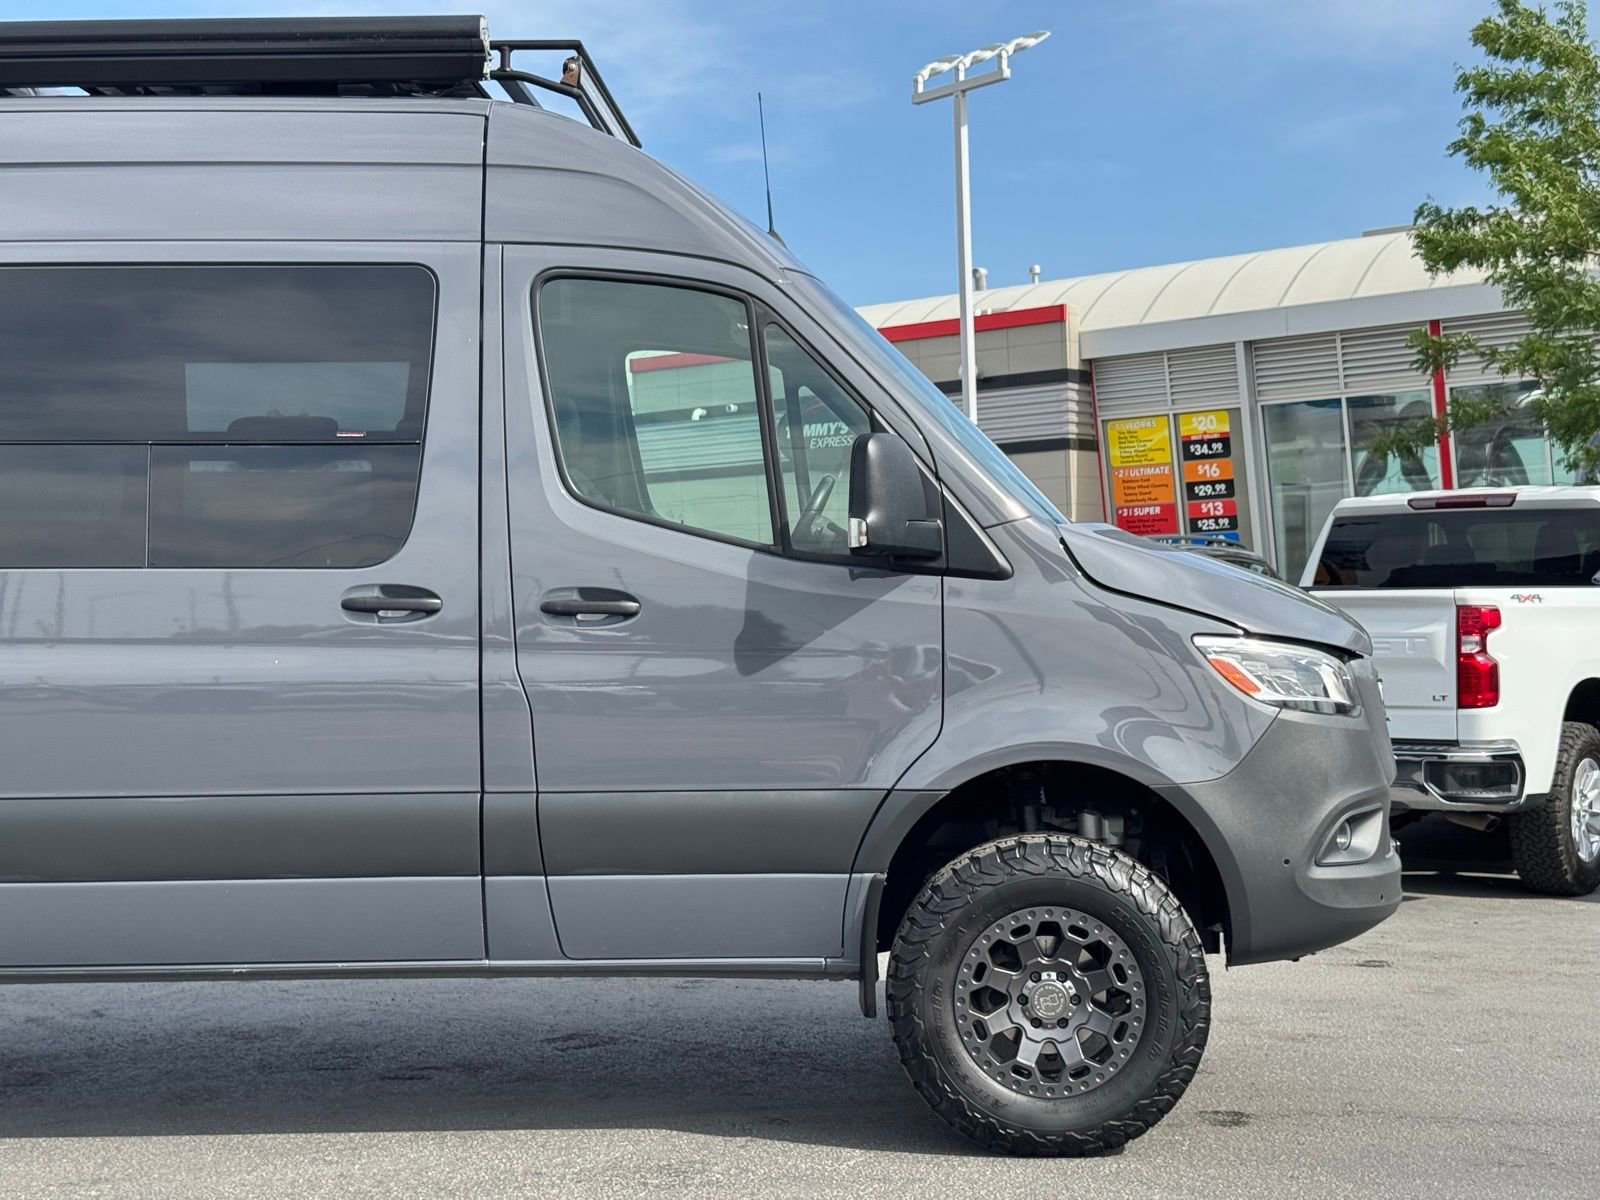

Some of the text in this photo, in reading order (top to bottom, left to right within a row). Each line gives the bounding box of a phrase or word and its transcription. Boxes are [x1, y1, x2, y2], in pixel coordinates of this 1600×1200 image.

[1192, 415, 1217, 430] $20
[786, 422, 849, 439] MMY'S
[810, 435, 854, 449] EXPRESS
[1190, 442, 1223, 456] $34.99
[1130, 466, 1169, 476] ULTIMATE
[1197, 463, 1220, 478] $16
[1194, 483, 1226, 496] $29.99
[1133, 507, 1160, 516] SUPER
[1201, 501, 1224, 516] $13
[1197, 517, 1230, 530] $25.99
[1432, 694, 1448, 702] LT
